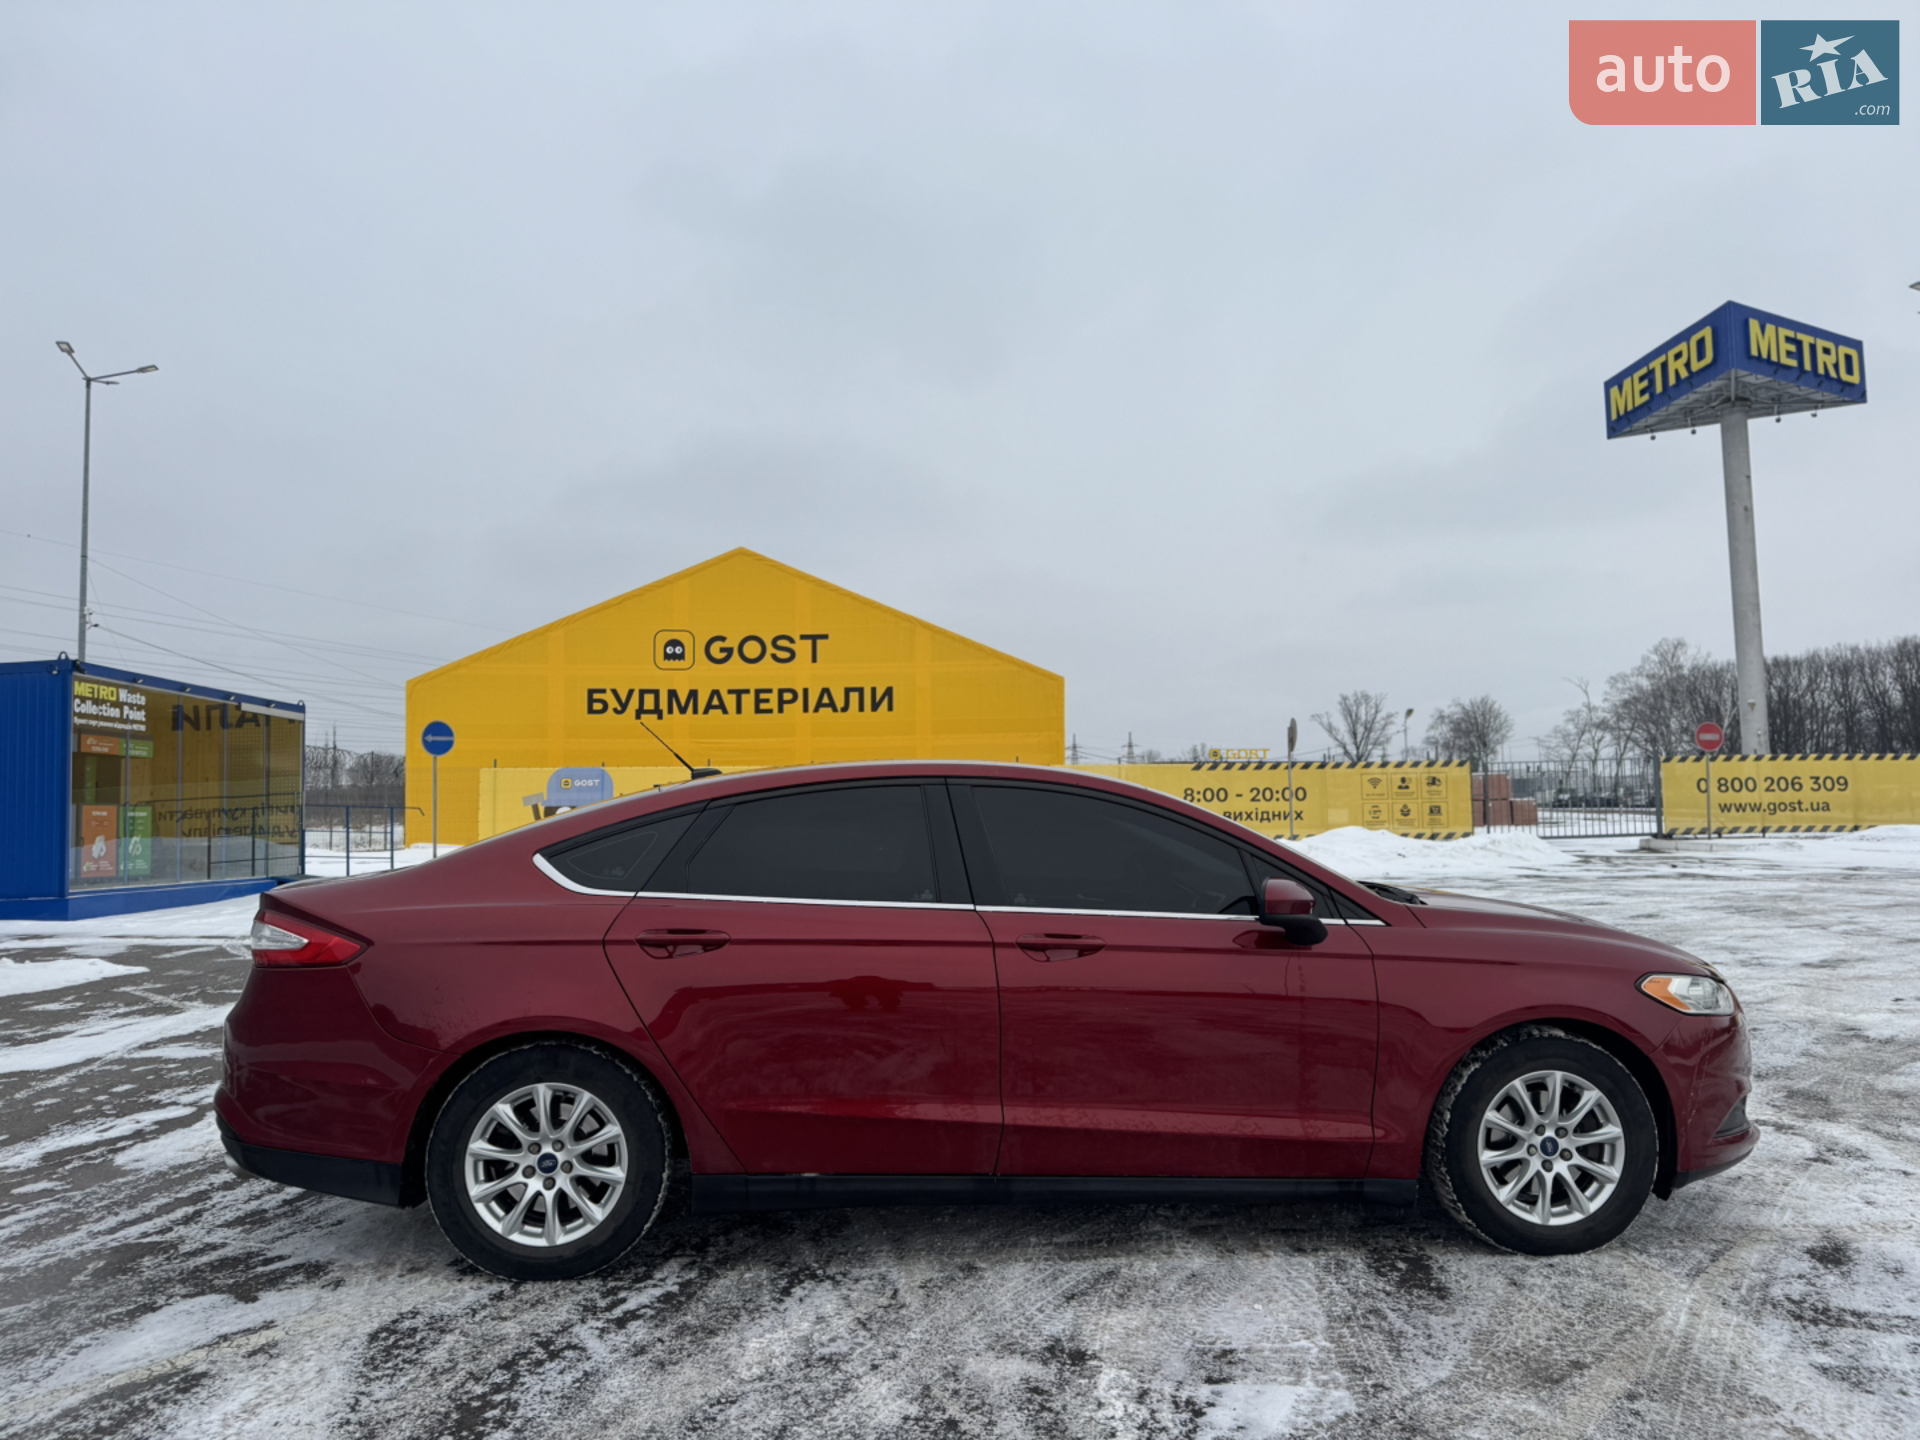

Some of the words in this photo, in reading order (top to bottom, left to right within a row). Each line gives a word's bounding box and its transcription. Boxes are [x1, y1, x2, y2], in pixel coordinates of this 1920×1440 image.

[1749, 317, 1861, 385] METRO
[1609, 325, 1714, 421] METRO
[704, 633, 829, 665] GOST
[74, 680, 117, 701] METRO
[118, 688, 146, 705] Waste
[586, 686, 894, 720] БУДМАТЕРІАЛИ
[74, 698, 121, 718] Collection
[123, 705, 146, 722] Point
[574, 779, 600, 787] GOST
[1183, 787, 1229, 803] 8:00
[1249, 786, 1307, 802] 20:00
[1717, 776, 1757, 793] 800
[1763, 776, 1804, 792] 206
[1809, 775, 1849, 792] 309
[1718, 799, 1831, 815] www.gost.ua
